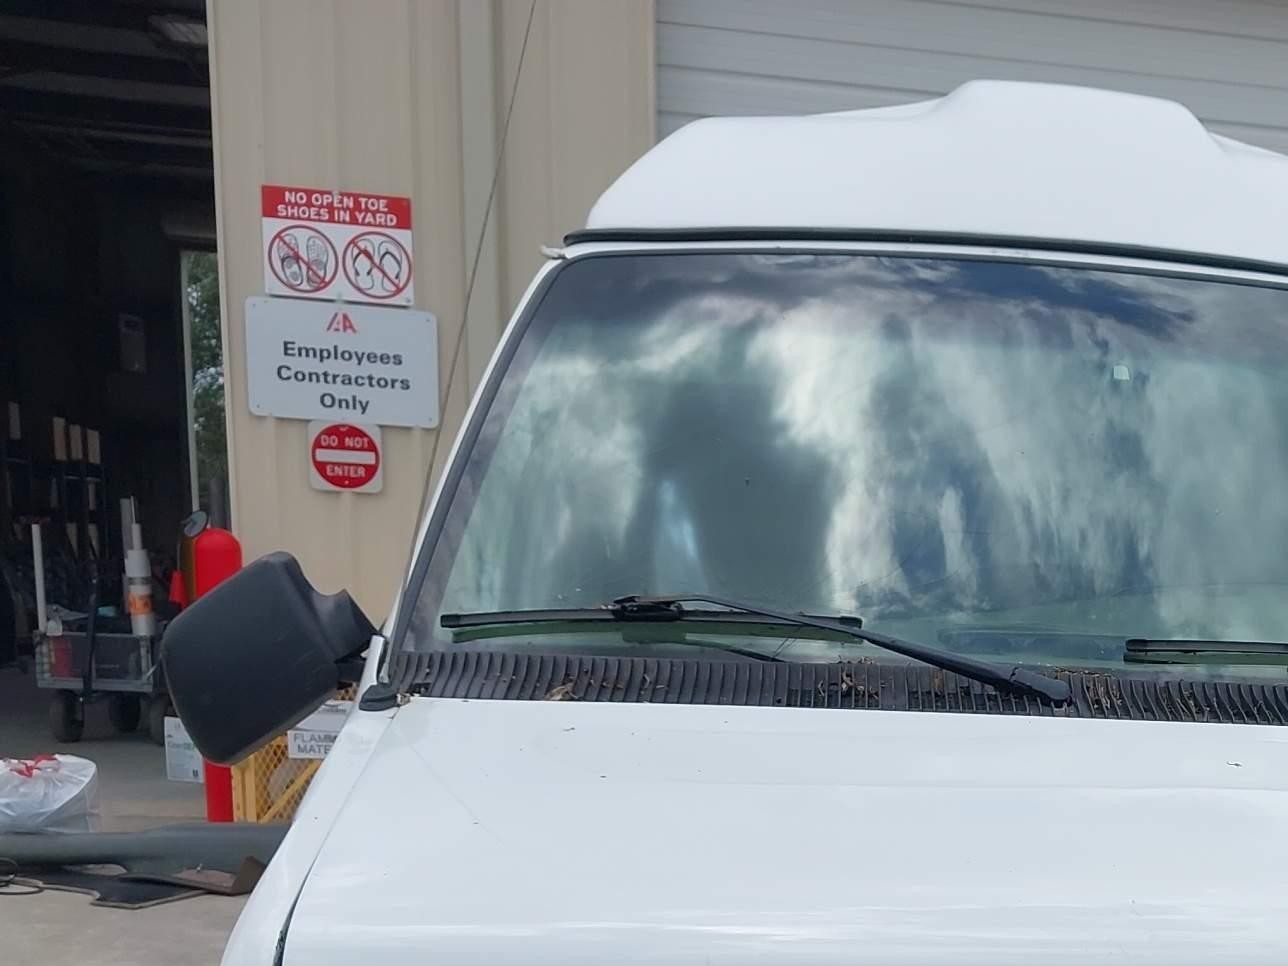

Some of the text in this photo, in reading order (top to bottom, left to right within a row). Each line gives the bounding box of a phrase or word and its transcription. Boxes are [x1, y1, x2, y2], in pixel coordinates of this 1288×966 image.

[284, 191, 389, 212] NO OPEN TOE
[277, 204, 397, 226] SHOES IN YARD
[282, 340, 403, 366] Employees
[276, 364, 411, 390] Contractors
[320, 392, 370, 415] Only
[320, 434, 369, 449] DO NOT
[326, 464, 366, 478] ENTER
[297, 743, 334, 754] MATE
